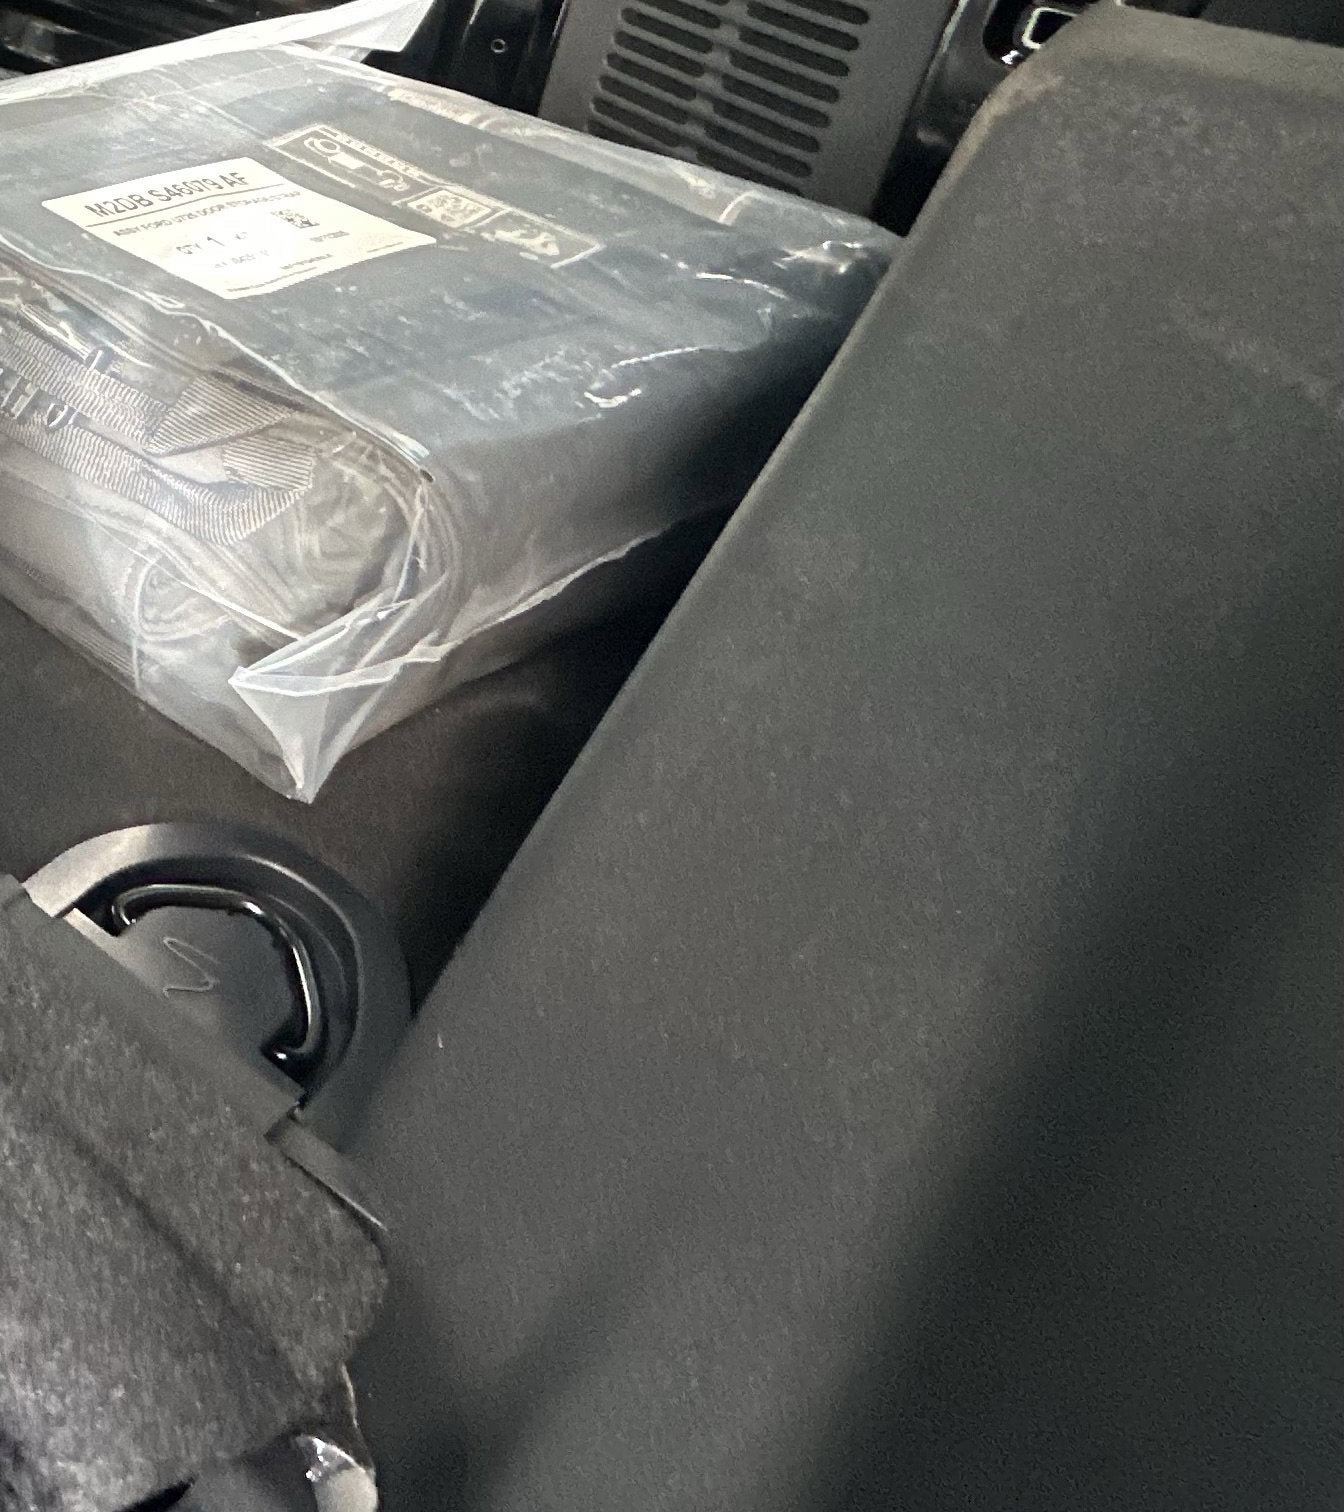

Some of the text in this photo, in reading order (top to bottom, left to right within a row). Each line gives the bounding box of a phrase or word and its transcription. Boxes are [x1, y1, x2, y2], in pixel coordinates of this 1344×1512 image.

[84, 170, 250, 217] M2DB S46079 AF
[175, 241, 202, 255] QTY
[206, 235, 224, 248] 1
